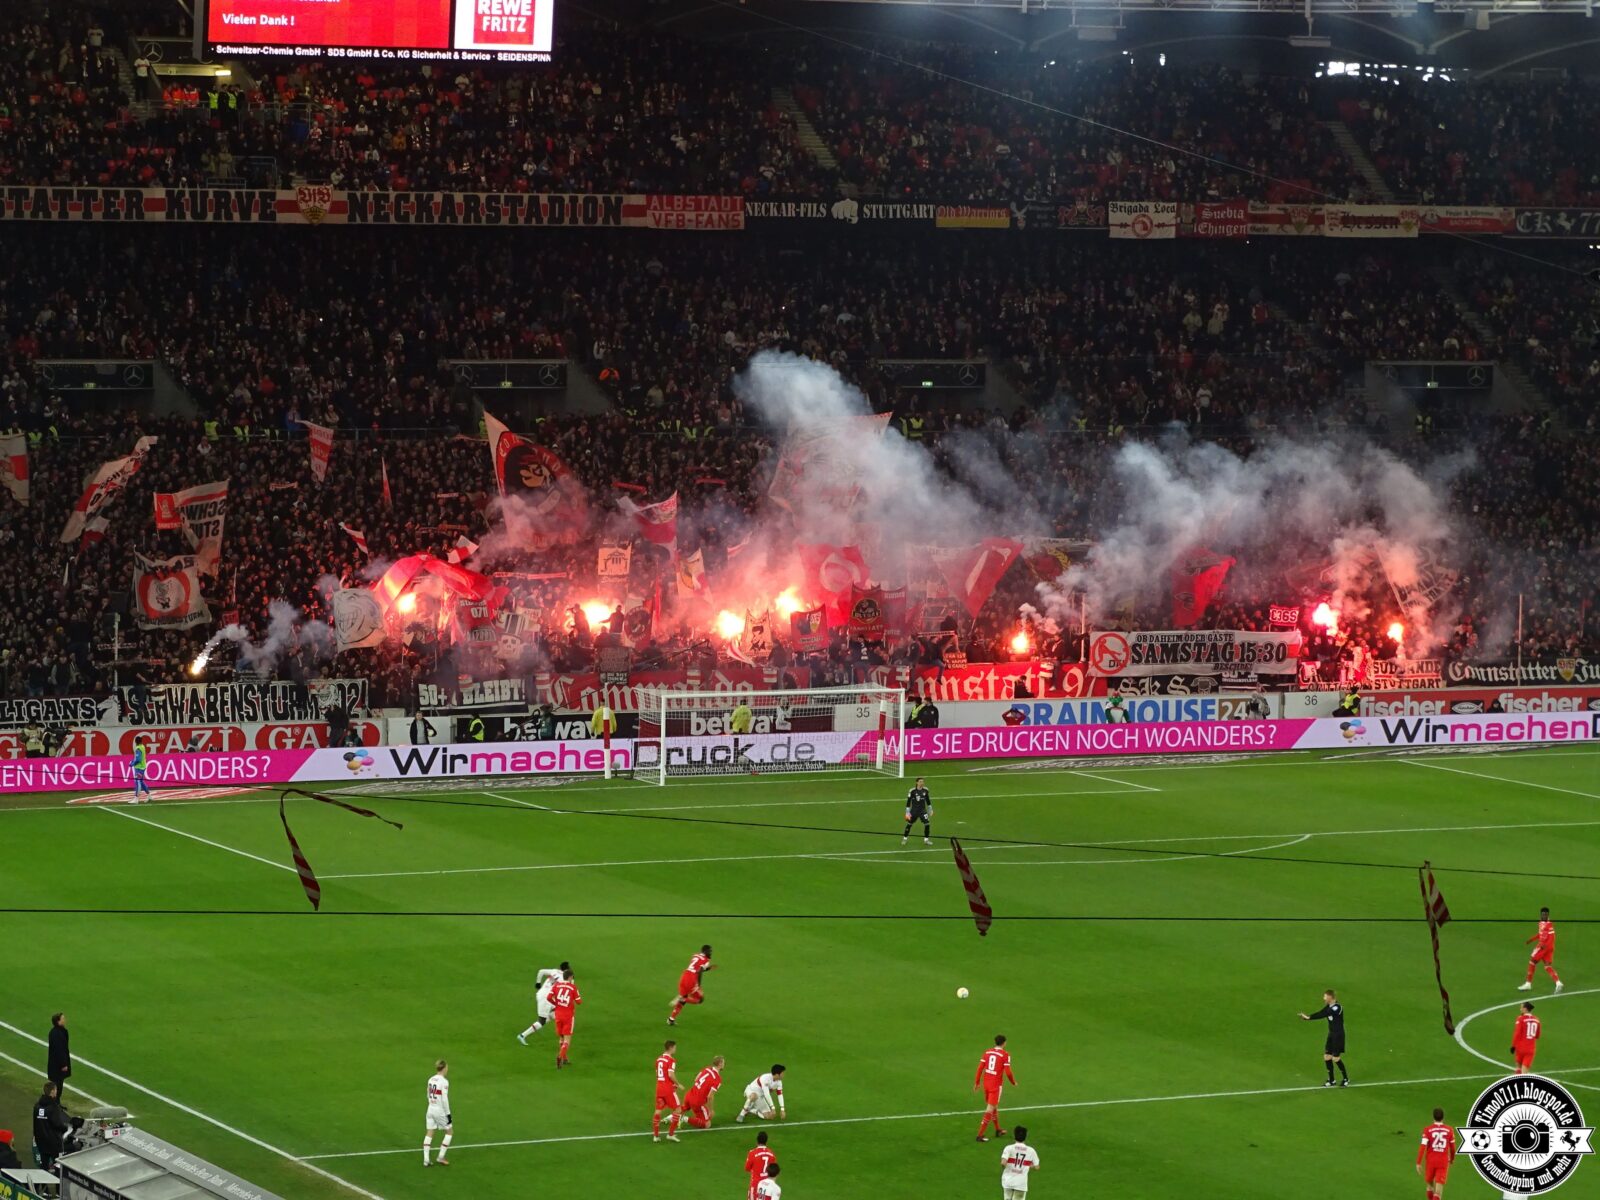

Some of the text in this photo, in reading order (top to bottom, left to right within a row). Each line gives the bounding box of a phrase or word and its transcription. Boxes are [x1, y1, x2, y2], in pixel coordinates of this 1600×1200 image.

[222, 13, 295, 26] Vielen Dank !
[482, 16, 527, 32] FRITZ
[216, 45, 293, 56] Schweitzer-Chemie
[295, 47, 321, 57] GmbH
[328, 48, 345, 57] SDS
[347, 49, 372, 58] GmbH
[374, 49, 380, 58] &
[381, 50, 395, 59] Co.
[397, 50, 410, 59] KG
[412, 50, 452, 60] Sicherheit
[453, 52, 460, 60] &
[461, 52, 491, 61] Service
[0, 189, 276, 220] TATTER KURVE
[347, 192, 623, 225] NECKARSTADION
[648, 195, 744, 211] ALBSTADT
[745, 201, 936, 220] NECKAR-FILS STUTTGART
[1110, 203, 1176, 216] Brigada Loca
[651, 212, 741, 229] VFB-FANS
[1149, 633, 1183, 643] DAHEIM
[1132, 642, 1288, 664] SAMSTAG 15:30
[1449, 660, 1557, 682] Cannstatter
[1304, 695, 1318, 706] 36
[1360, 695, 1446, 716] fischer
[1499, 692, 1582, 713] fischer
[856, 706, 870, 718] 35
[932, 733, 963, 754] SIE
[968, 730, 1069, 753] DRUCKEN
[1076, 728, 1139, 750] NOCH
[1144, 724, 1278, 749] WOANDERS?
[42, 762, 120, 785] NOCH
[688, 957, 699, 971] 2
[556, 988, 571, 1003] 44
[1526, 1021, 1538, 1039] 10
[656, 1061, 665, 1078] 6
[988, 1054, 997, 1071] 8
[696, 1072, 709, 1090] 4
[1431, 1131, 1448, 1149] 25
[761, 1156, 769, 1174] 7
[1014, 1152, 1026, 1168] 17
